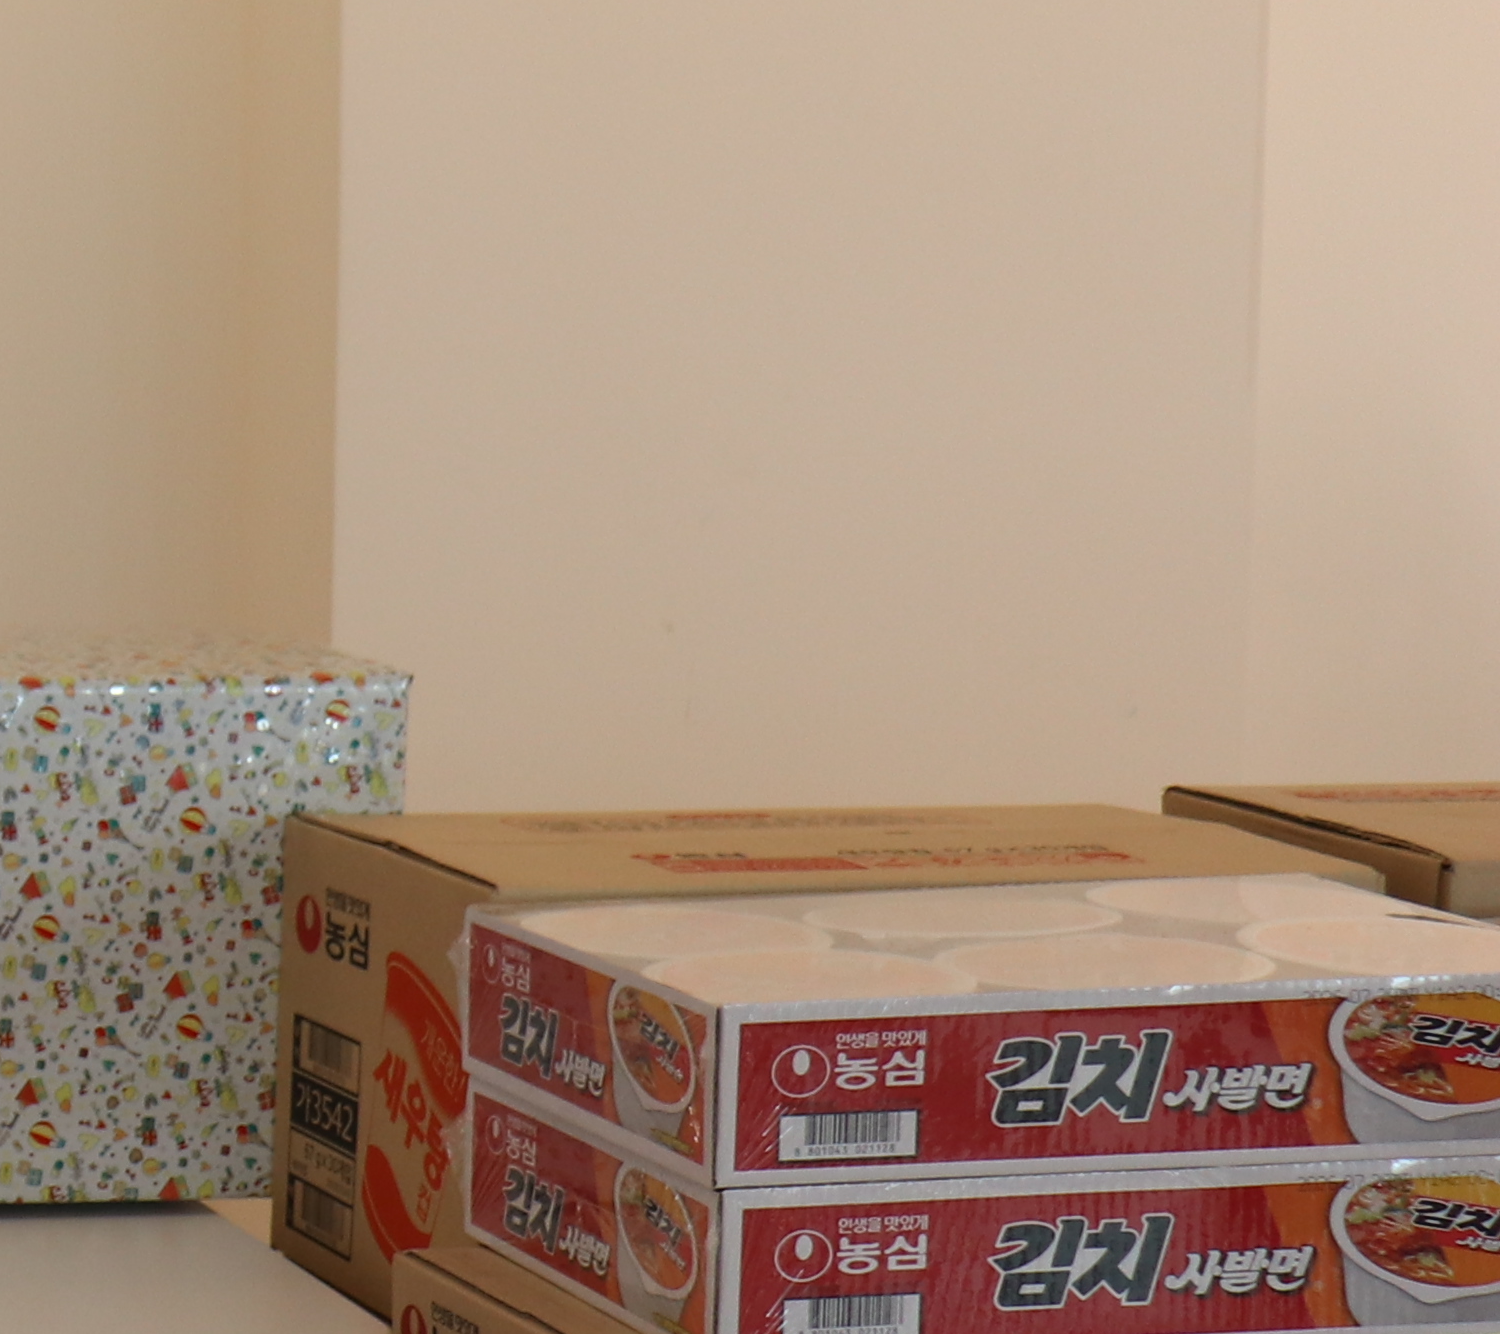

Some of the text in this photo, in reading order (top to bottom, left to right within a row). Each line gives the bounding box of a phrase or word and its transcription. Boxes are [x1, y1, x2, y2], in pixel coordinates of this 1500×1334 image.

[324, 909, 371, 971] 농심
[500, 955, 531, 993] 농심
[498, 993, 560, 1082] 김치
[836, 1030, 926, 1048] 인생을 맛있게
[834, 1049, 925, 1088] 농심
[985, 1029, 1311, 1126] 김치 사발면
[504, 1132, 538, 1167] 농심
[503, 1165, 567, 1256] 김치
